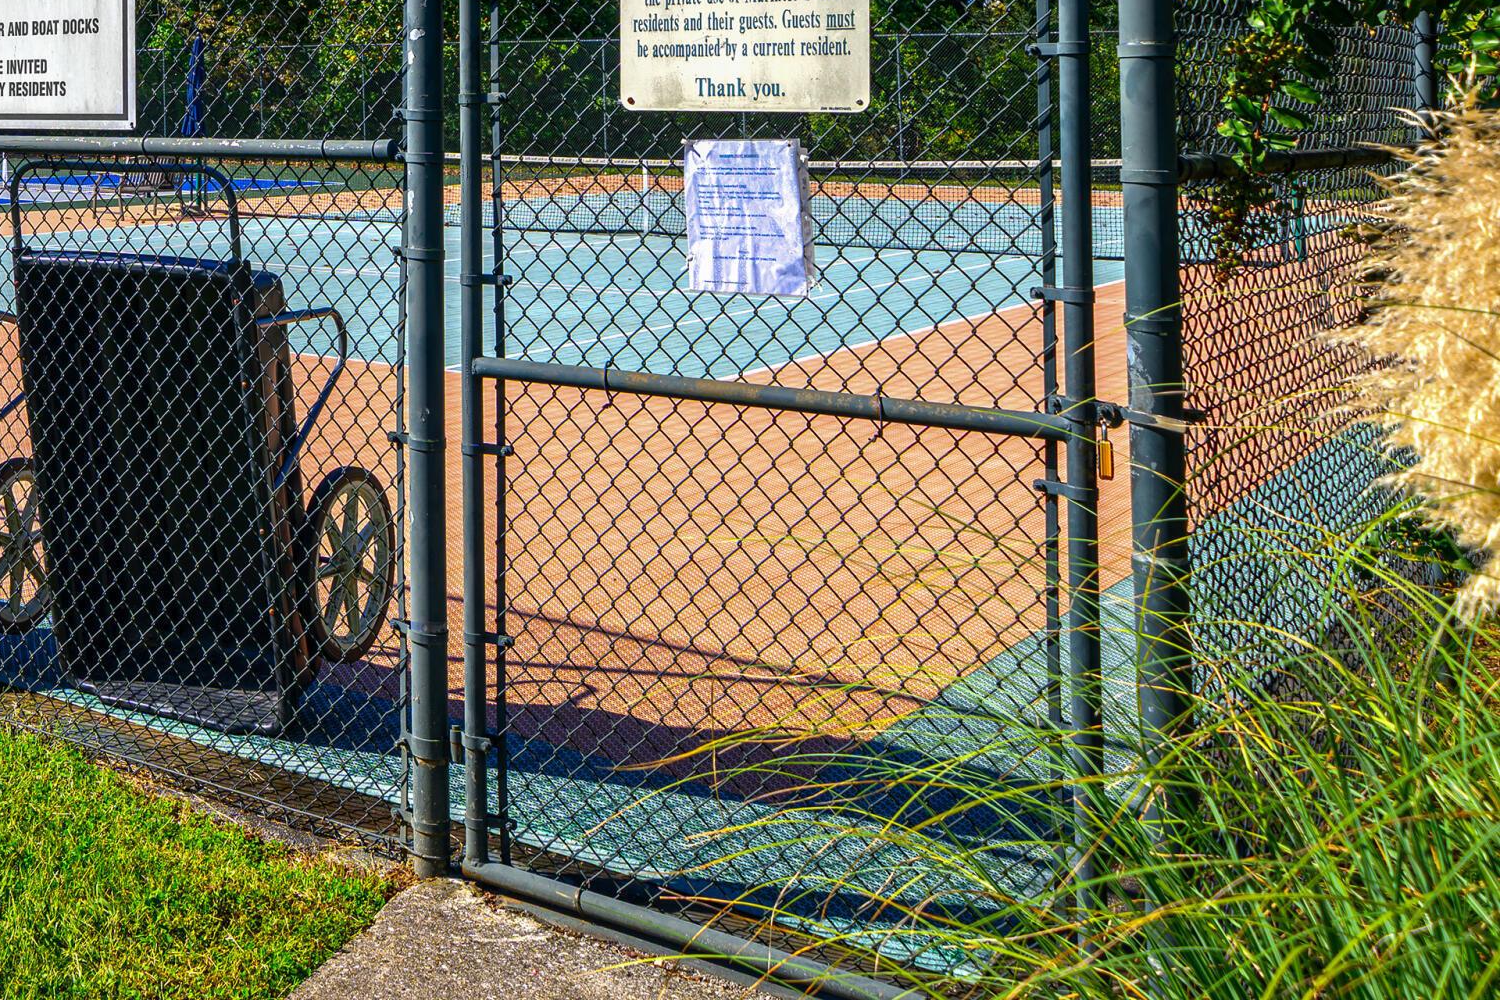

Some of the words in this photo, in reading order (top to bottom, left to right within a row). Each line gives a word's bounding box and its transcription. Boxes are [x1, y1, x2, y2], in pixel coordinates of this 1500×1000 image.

[7, 21, 29, 37] AND
[31, 19, 60, 36] BOAT
[62, 17, 100, 35] DOCKS
[633, 13, 680, 33] residents
[683, 12, 703, 32] and
[706, 10, 735, 31] their
[738, 11, 778, 35] guests.
[781, 8, 821, 29] Guests
[825, 8, 856, 31] must
[637, 39, 649, 58] be
[652, 37, 721, 62] accompanied
[724, 37, 738, 62] by
[741, 42, 748, 57] a
[752, 38, 796, 57] current
[800, 35, 851, 56] resident.
[6, 58, 48, 75] INVITED
[8, 80, 67, 97] RESIDENTS
[694, 77, 747, 98] Thank
[753, 82, 786, 102] you.
